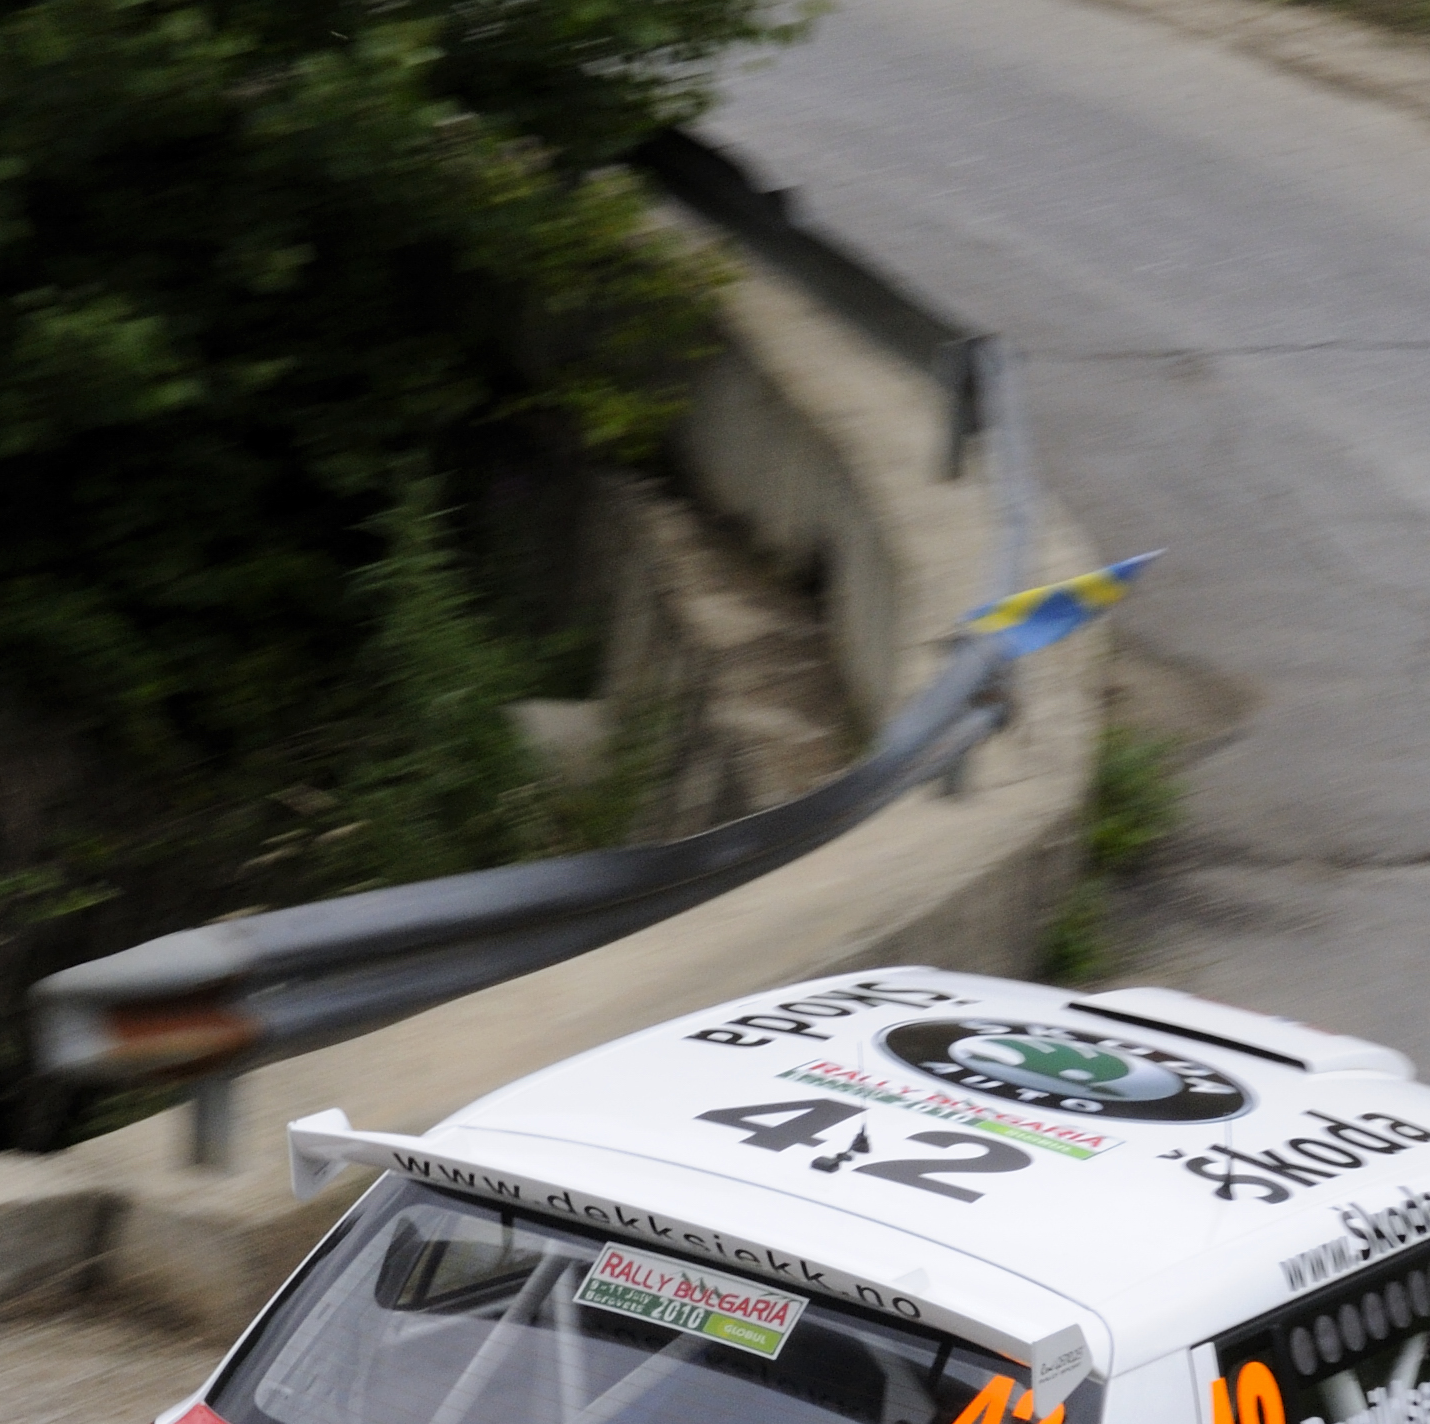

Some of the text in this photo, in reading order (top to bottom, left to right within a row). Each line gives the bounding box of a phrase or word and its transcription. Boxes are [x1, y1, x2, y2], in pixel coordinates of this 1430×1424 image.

[919, 1059, 1105, 1114] AUTO
[692, 1098, 1034, 1205] 42
[599, 1250, 790, 1327] RALLY BULGARIA
[650, 1297, 705, 1329] 2010
[723, 1322, 768, 1345] GLOBUL
